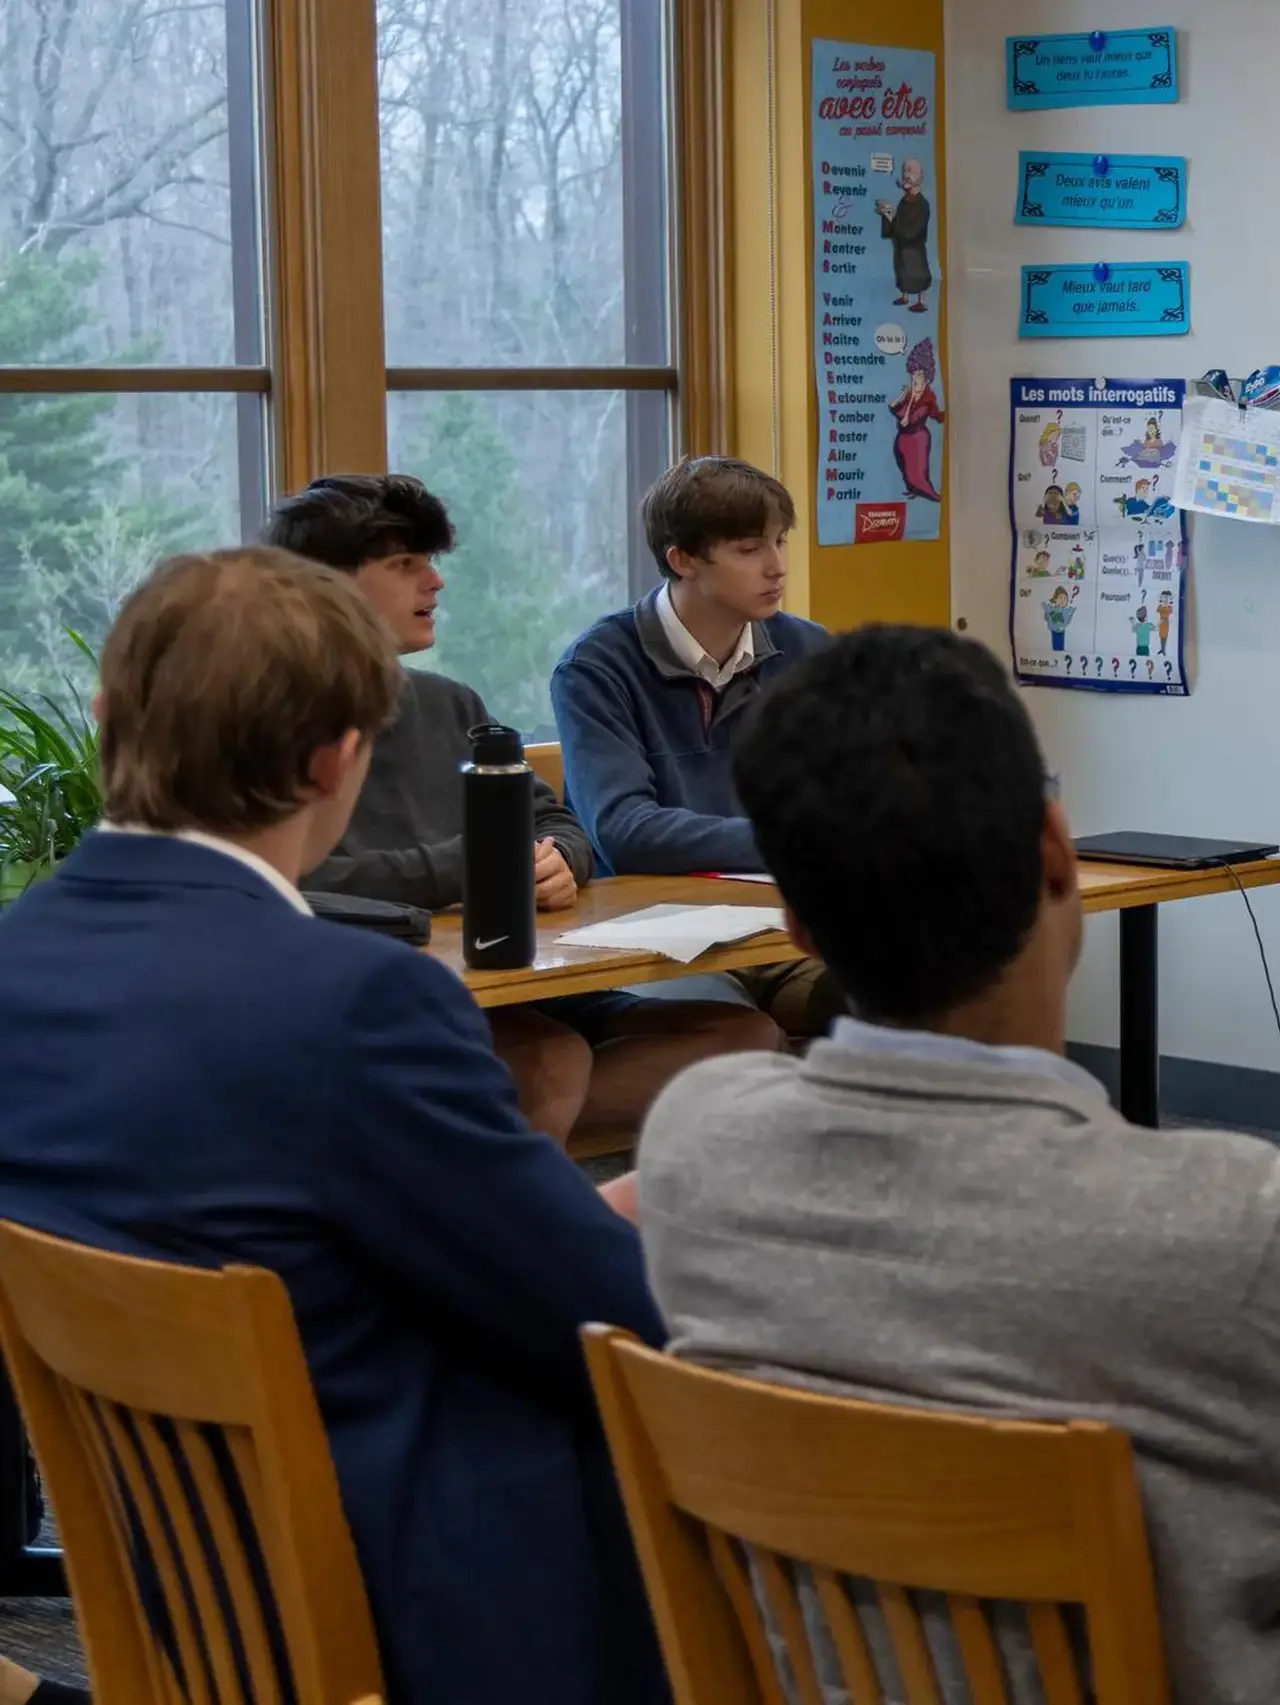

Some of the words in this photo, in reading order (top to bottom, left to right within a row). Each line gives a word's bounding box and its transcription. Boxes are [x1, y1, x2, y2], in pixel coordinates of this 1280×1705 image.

[832, 57, 850, 72] Les
[1036, 54, 1050, 66] Un
[819, 96, 876, 120] avec
[882, 82, 928, 120] être
[822, 161, 866, 177] Devenir
[823, 181, 867, 196] Revenir
[1056, 174, 1084, 188] Deux
[1088, 176, 1113, 189] avis
[1061, 196, 1096, 208] mieux
[822, 220, 864, 235] Monter
[823, 240, 866, 255] Rentrer
[823, 259, 856, 274] Sortir
[1062, 280, 1096, 293] Mieux
[1100, 281, 1124, 293] vaut
[1127, 280, 1151, 292] tard
[823, 292, 853, 307] Venir
[1072, 303, 1094, 315] que
[1096, 300, 1140, 315] jamais.
[823, 312, 862, 326] Arriver
[823, 332, 860, 346] Naître
[824, 352, 886, 365] Descendre
[827, 371, 864, 384] Entrer
[828, 390, 886, 404] Retourner
[1021, 386, 1044, 401] Les
[1049, 386, 1085, 402] mots
[1089, 385, 1176, 406] interrogatifs
[829, 410, 875, 423] Tomber
[830, 429, 868, 442] Rester
[828, 448, 857, 462] Aller
[826, 468, 865, 481] Mourir
[827, 487, 861, 501] Partir
